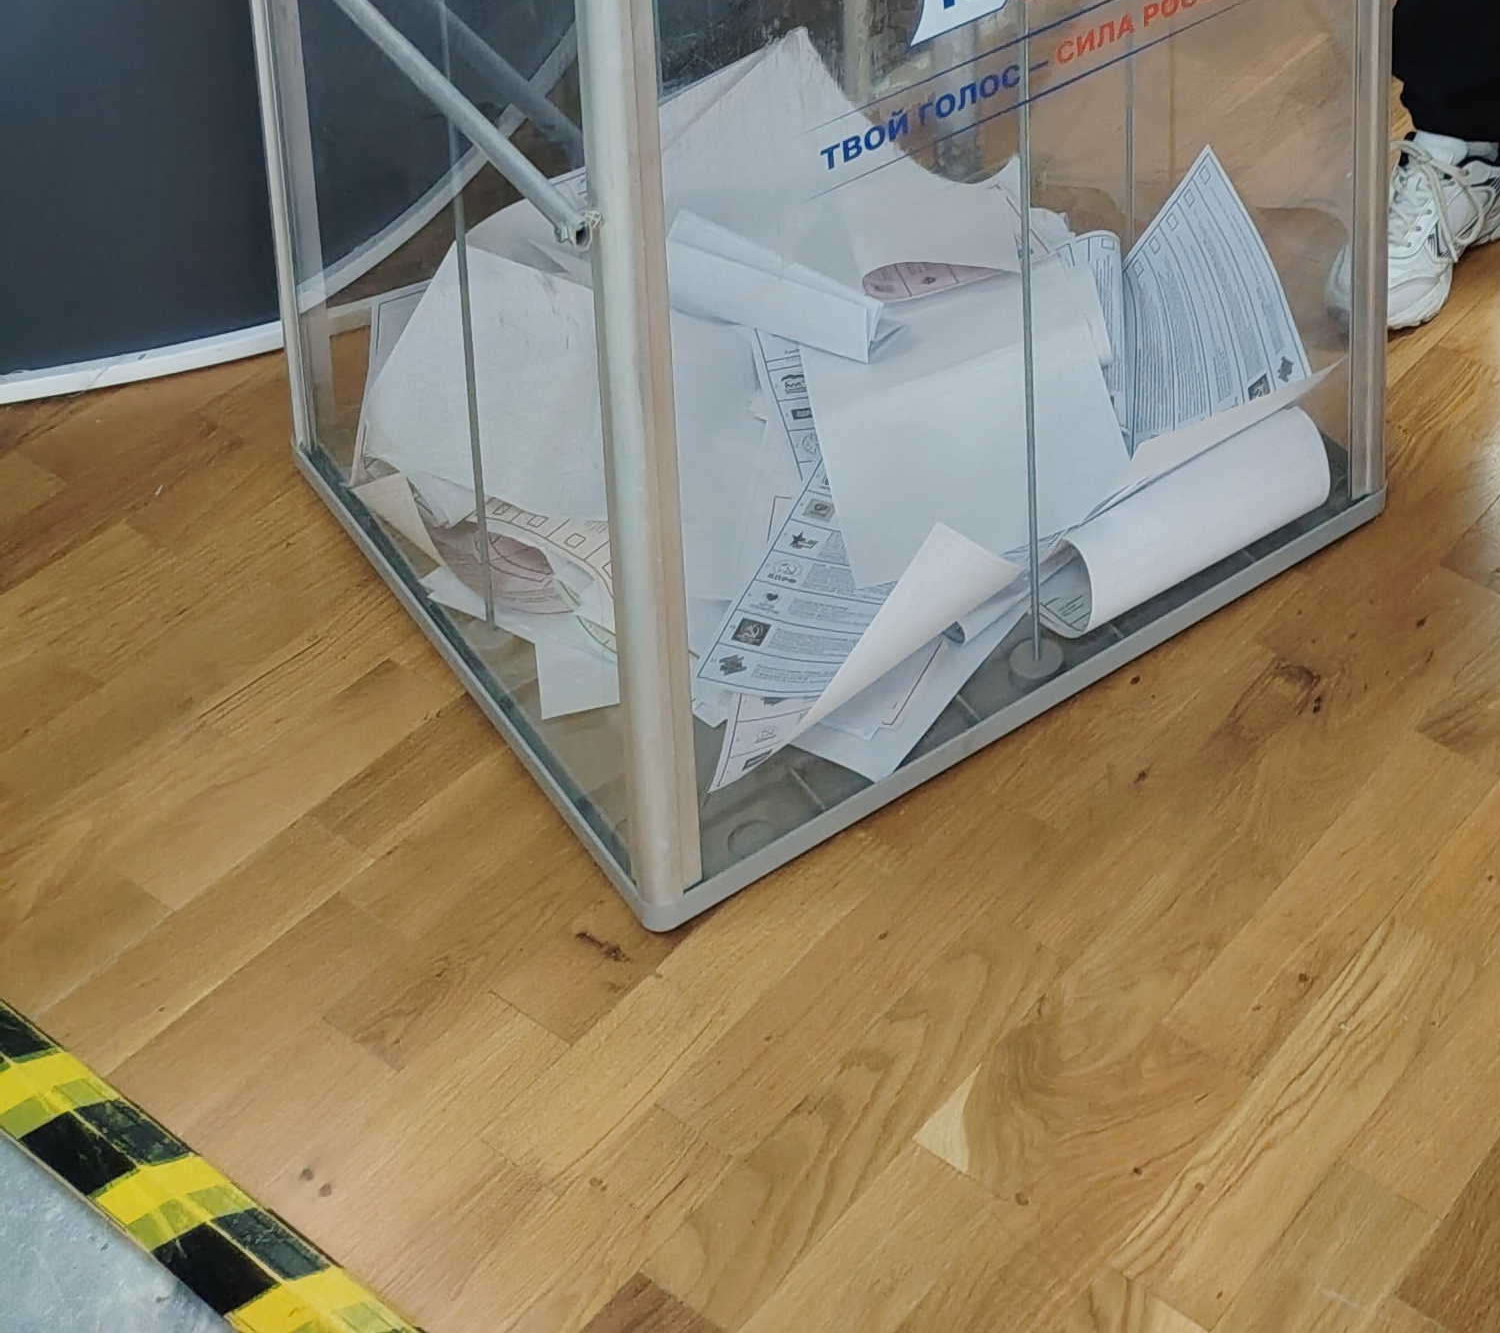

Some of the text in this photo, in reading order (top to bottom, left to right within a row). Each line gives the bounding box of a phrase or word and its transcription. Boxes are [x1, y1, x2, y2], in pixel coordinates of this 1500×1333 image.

[820, 110, 909, 169] ТВОЙ
[918, 64, 1022, 121] ГОЛОС
[1055, 17, 1134, 67] СИЛА
